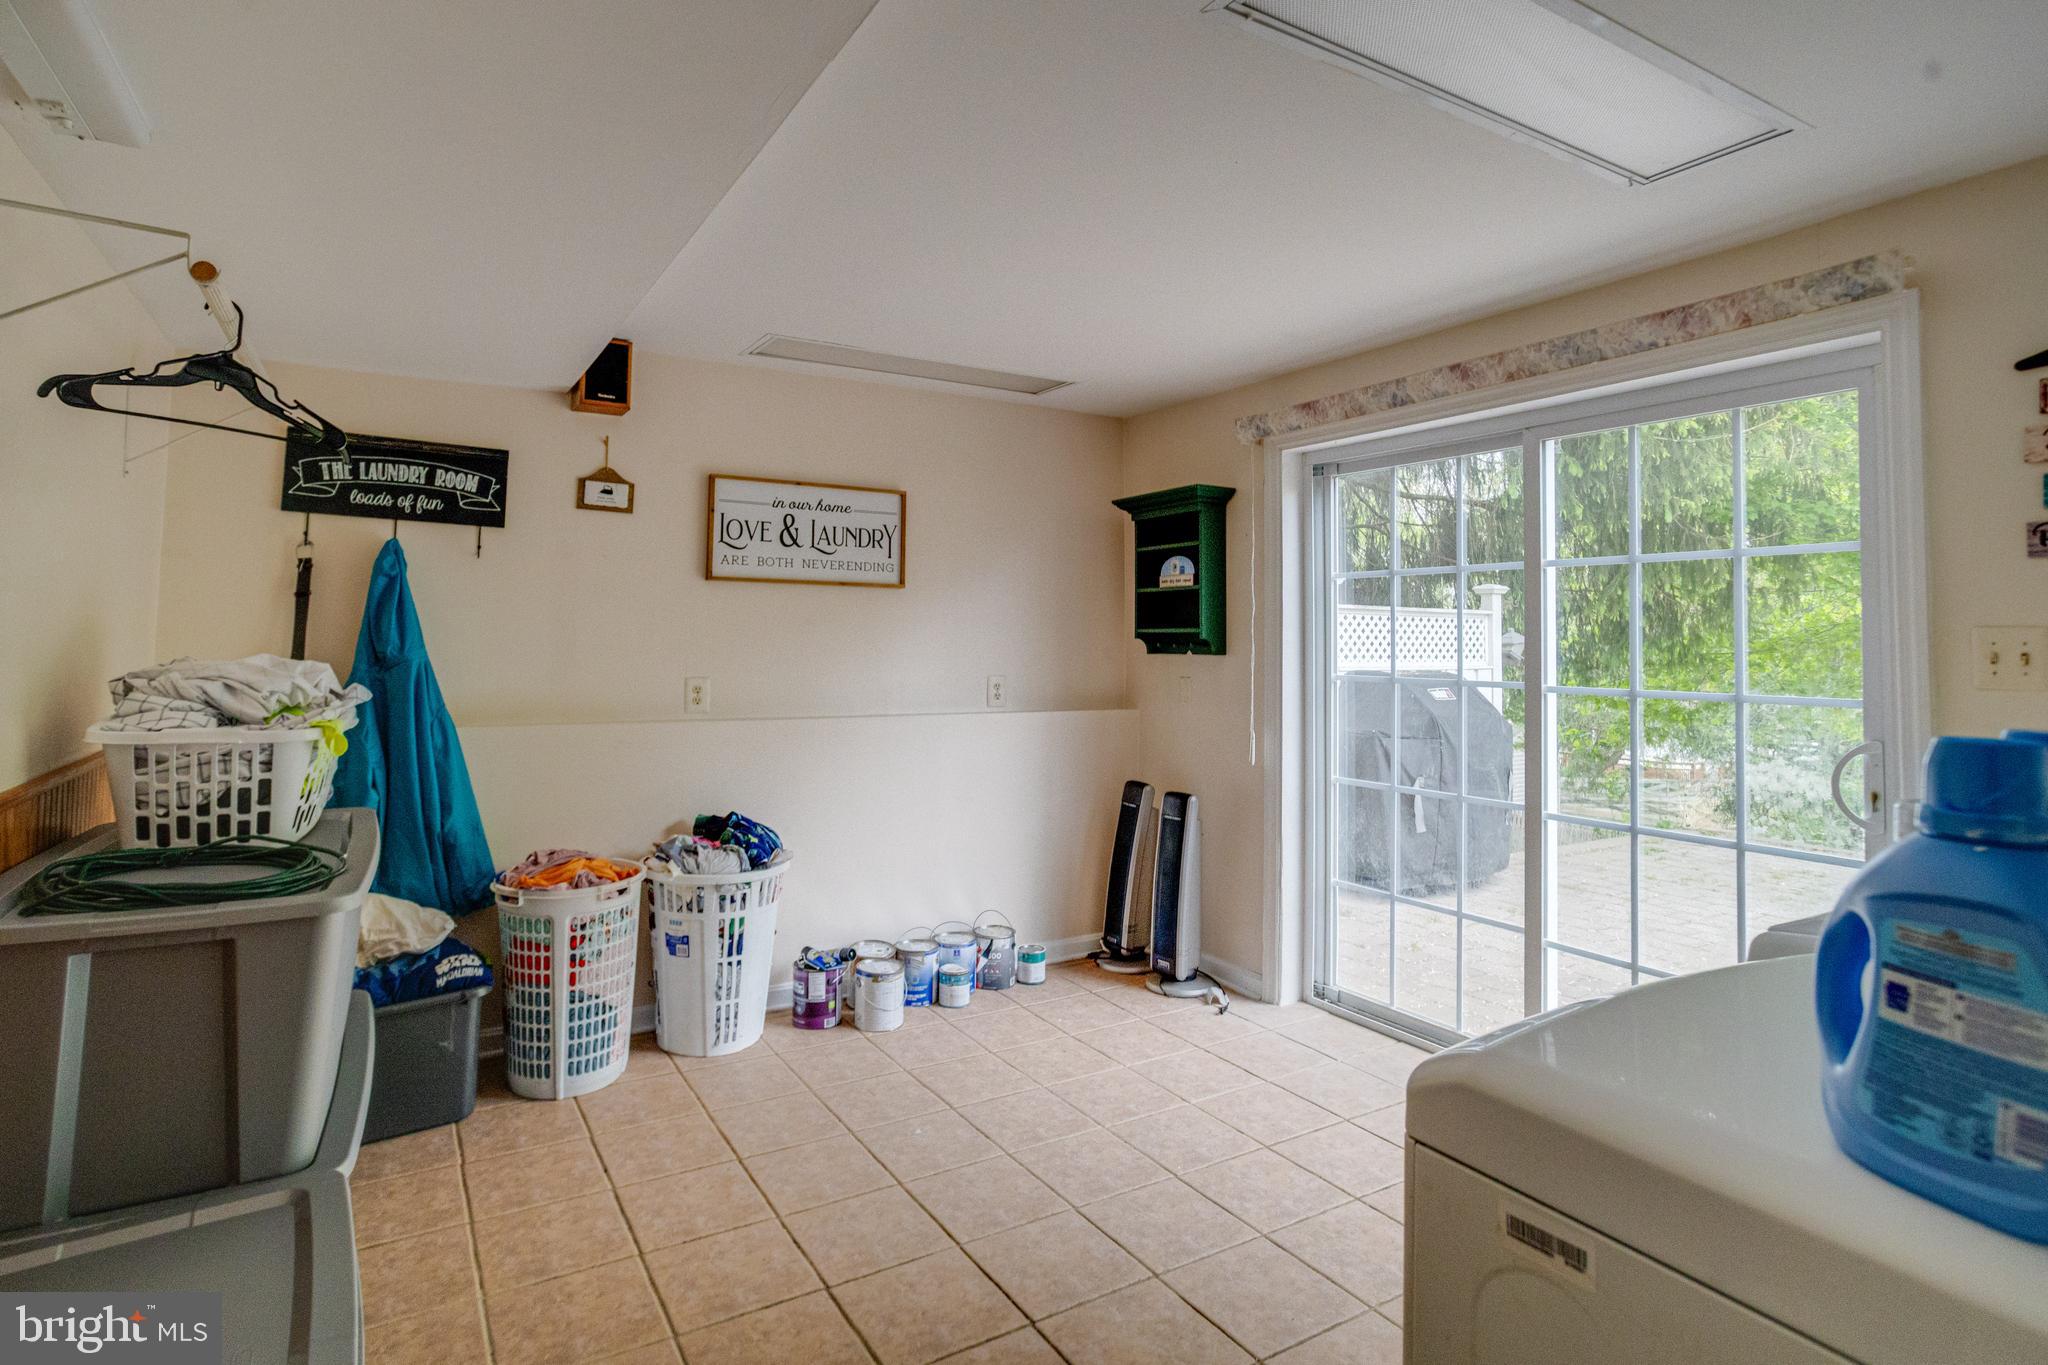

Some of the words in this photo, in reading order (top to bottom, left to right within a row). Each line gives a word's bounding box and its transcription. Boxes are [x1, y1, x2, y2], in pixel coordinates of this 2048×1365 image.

[319, 462, 353, 480] THE
[359, 461, 429, 484] LAUNDRY
[435, 471, 480, 493] ROOM
[350, 488, 394, 506] loads
[397, 494, 416, 513] of
[416, 494, 444, 514] fun
[771, 497, 786, 509] in
[788, 501, 814, 511] our
[814, 498, 853, 514] home
[779, 513, 804, 548] &
[720, 554, 749, 566] ARE
[757, 556, 794, 569] BOTH
[802, 559, 895, 573] NEVERENDING
